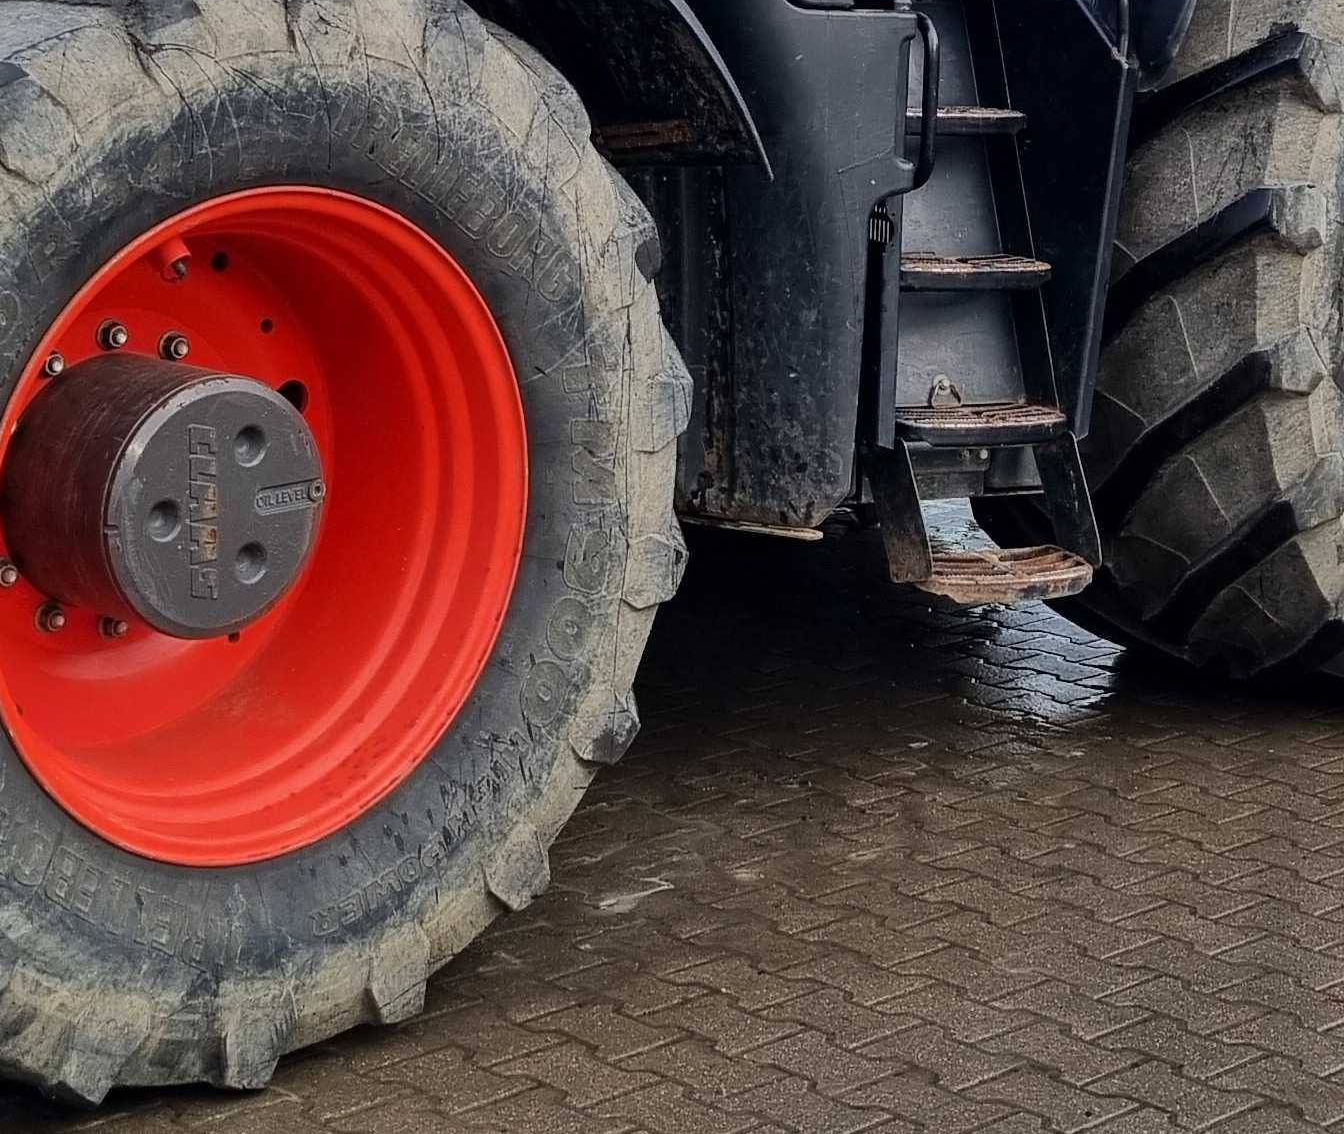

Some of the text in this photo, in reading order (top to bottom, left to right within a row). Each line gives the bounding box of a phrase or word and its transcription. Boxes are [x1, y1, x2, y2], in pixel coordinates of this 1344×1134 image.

[187, 424, 219, 600] CLAAS
[255, 487, 308, 508] OIL LEVEL
[306, 832, 449, 938] POWER
